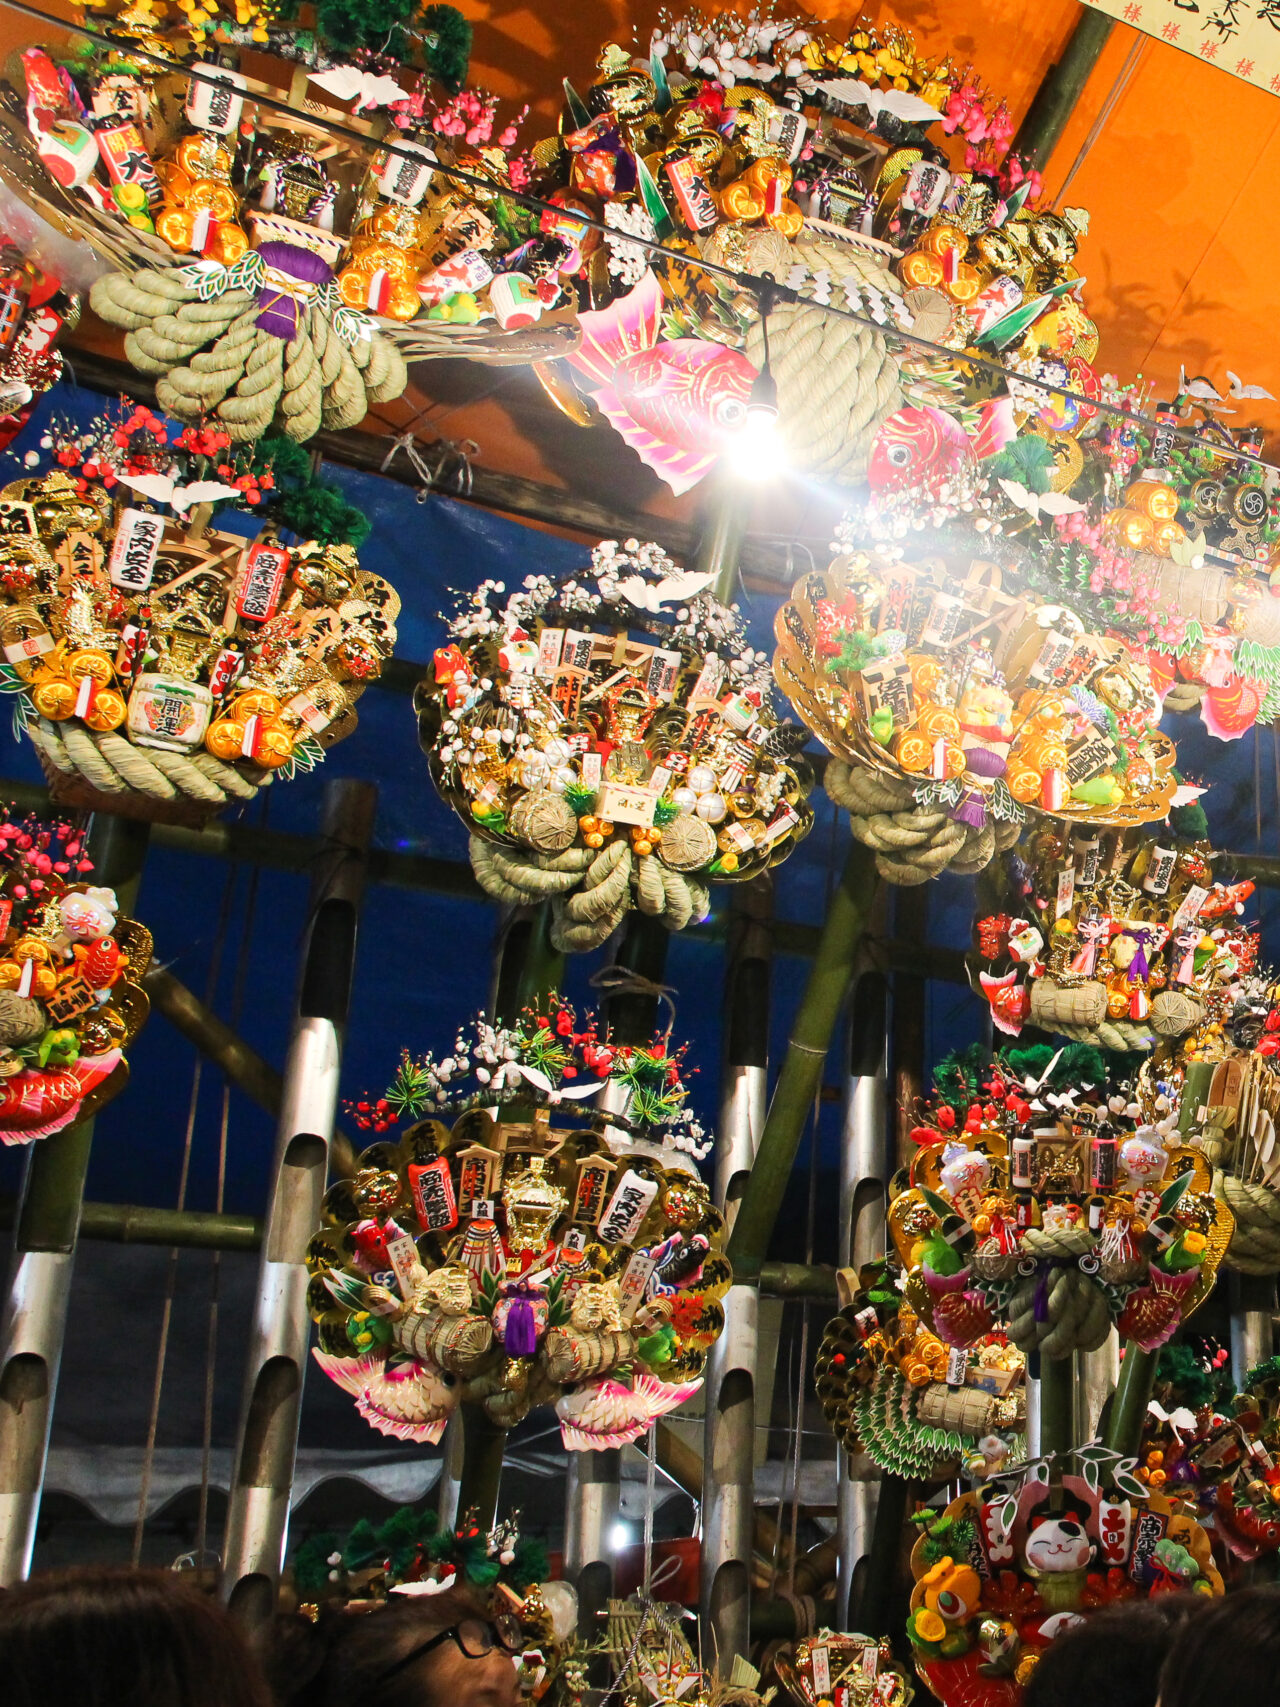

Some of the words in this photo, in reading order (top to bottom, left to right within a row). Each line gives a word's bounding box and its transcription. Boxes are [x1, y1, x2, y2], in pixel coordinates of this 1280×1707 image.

[120, 520, 158, 585] 家内安全
[156, 697, 184, 737] 開運
[476, 1201, 490, 1218] め組
[602, 1186, 646, 1245] 家内安全
